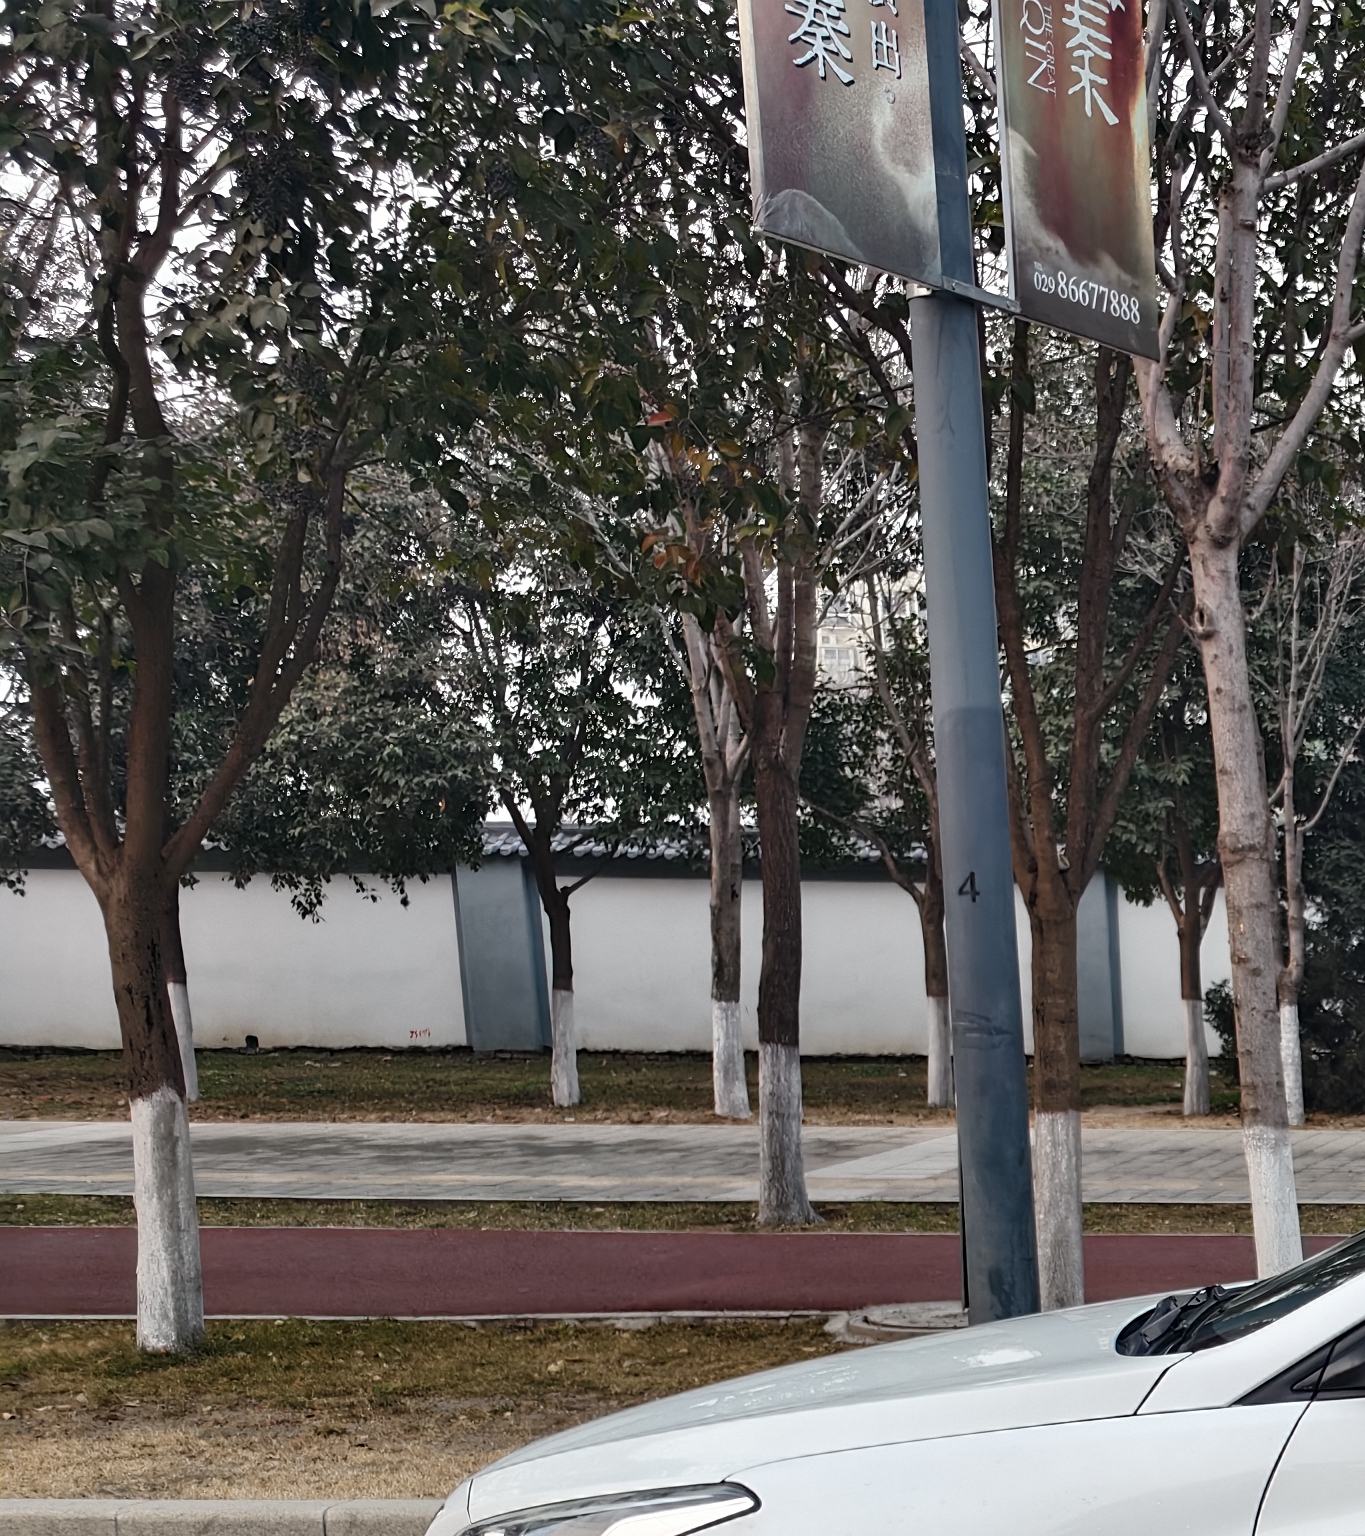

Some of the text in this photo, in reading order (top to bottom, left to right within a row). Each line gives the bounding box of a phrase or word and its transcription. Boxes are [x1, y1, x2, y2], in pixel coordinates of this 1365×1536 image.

[868, 0, 901, 79] 出
[1020, 0, 1049, 93] QIN
[1043, 4, 1057, 98] THE GREAT
[958, 871, 980, 903] 4
